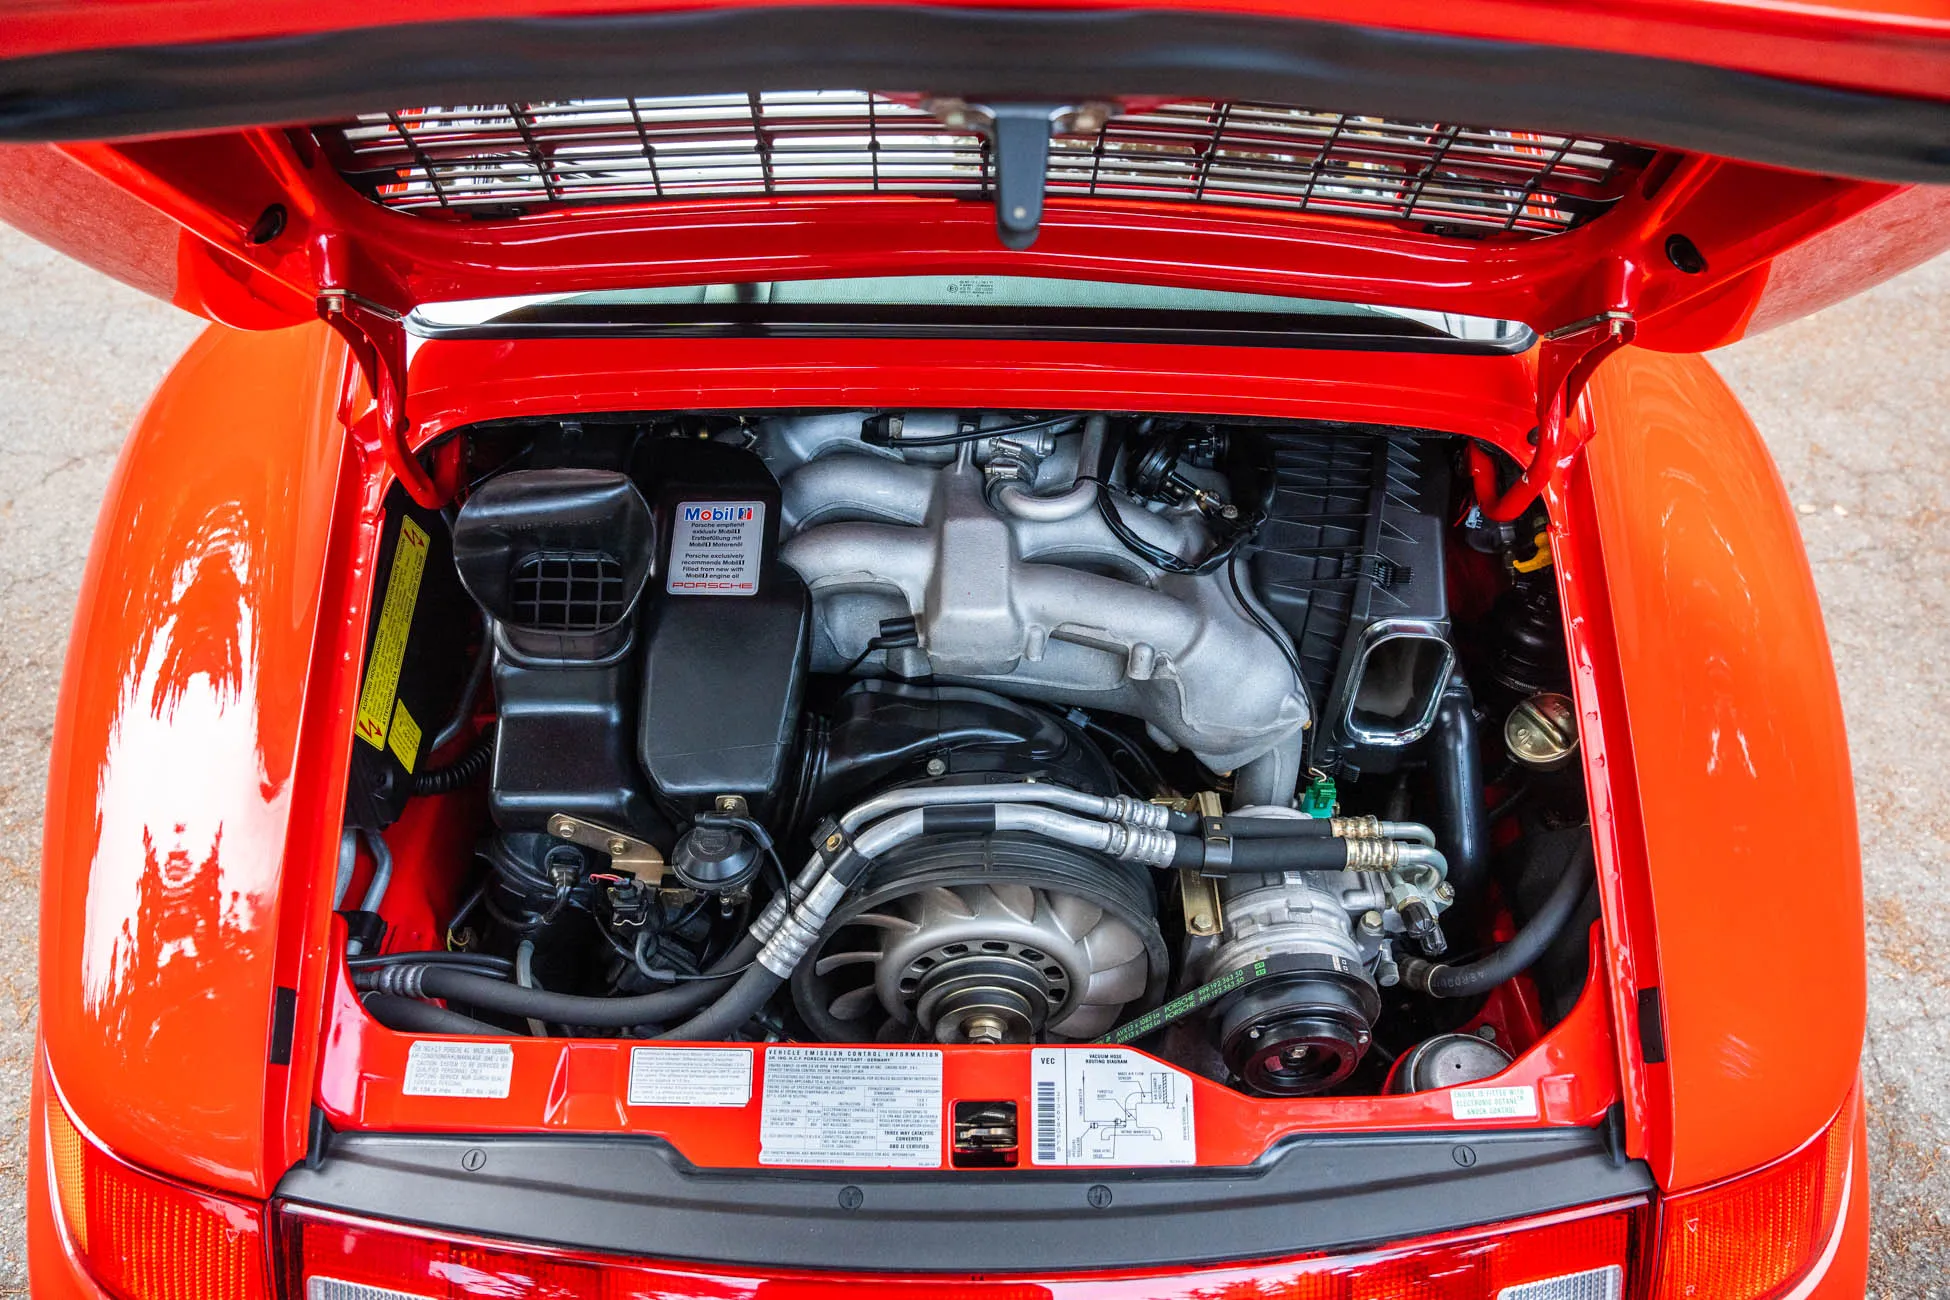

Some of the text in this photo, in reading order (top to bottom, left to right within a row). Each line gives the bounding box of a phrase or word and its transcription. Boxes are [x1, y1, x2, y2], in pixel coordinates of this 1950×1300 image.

[685, 508, 734, 520] Mobil
[1164, 994, 1194, 1013] PORSCHE
[1166, 1001, 1196, 1020] PORSCHE
